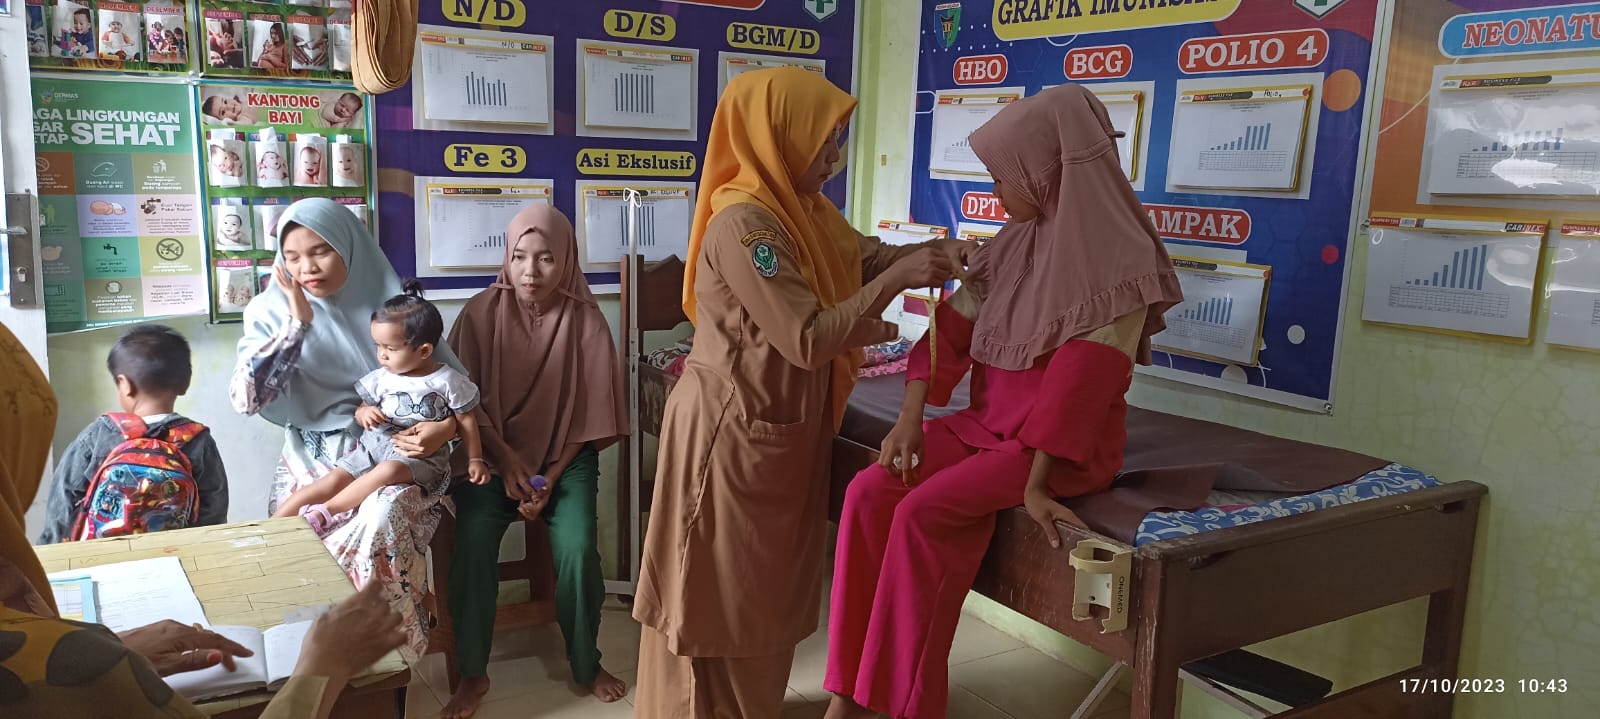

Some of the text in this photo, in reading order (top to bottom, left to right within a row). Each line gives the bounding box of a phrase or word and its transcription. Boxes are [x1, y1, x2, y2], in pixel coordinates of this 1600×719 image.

[453, 0, 515, 22] N/D
[998, 0, 1083, 25] GRAFIK
[614, 12, 666, 37] D/S
[731, 24, 816, 51] BGM/D
[1186, 34, 1318, 69] POLIO 4
[1070, 50, 1124, 76] BCG
[248, 93, 320, 108] KANTONG
[33, 108, 180, 124] GA LINGKUNGAN
[34, 121, 64, 133] GAR
[268, 111, 303, 124] BAYI
[35, 133, 69, 144] TAP
[71, 122, 181, 146] SEHAT
[453, 146, 518, 168] Fe 3
[578, 152, 694, 170] Asi Ekslusif
[966, 196, 1000, 217] DPT
[1147, 209, 1242, 239] AMPAK
